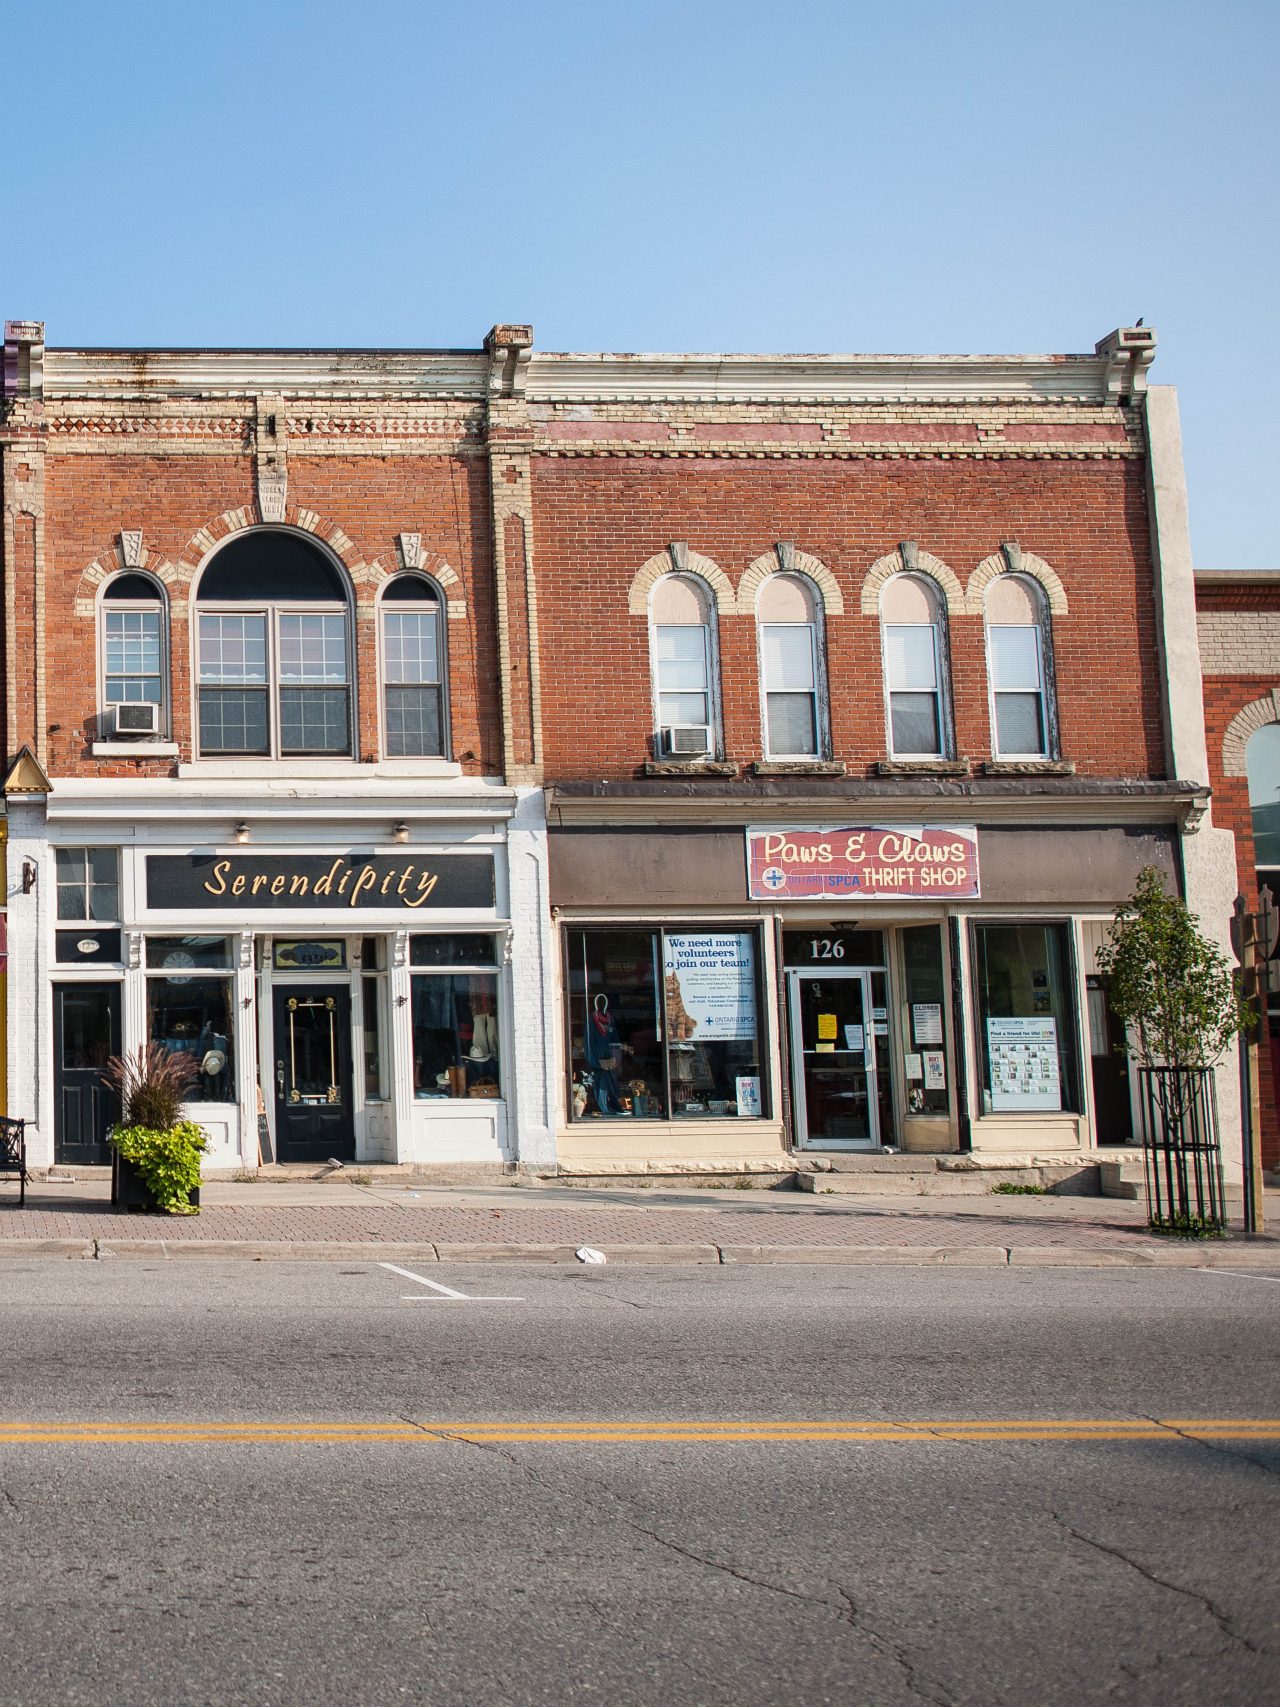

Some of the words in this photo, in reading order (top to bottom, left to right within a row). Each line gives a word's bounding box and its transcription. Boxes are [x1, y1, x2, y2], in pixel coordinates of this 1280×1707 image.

[765, 835, 833, 863] Paws
[845, 833, 866, 863] &
[878, 835, 966, 863] Claws
[204, 858, 438, 907] Serendipity
[829, 875, 860, 887] SPCA
[863, 867, 915, 887] THRIFT
[921, 867, 967, 886] SHOP
[668, 938, 686, 948] We
[688, 938, 713, 947] need
[810, 939, 845, 959] 126
[678, 949, 735, 958] volunteers
[676, 959, 697, 970] join
[720, 958, 750, 968] team!
